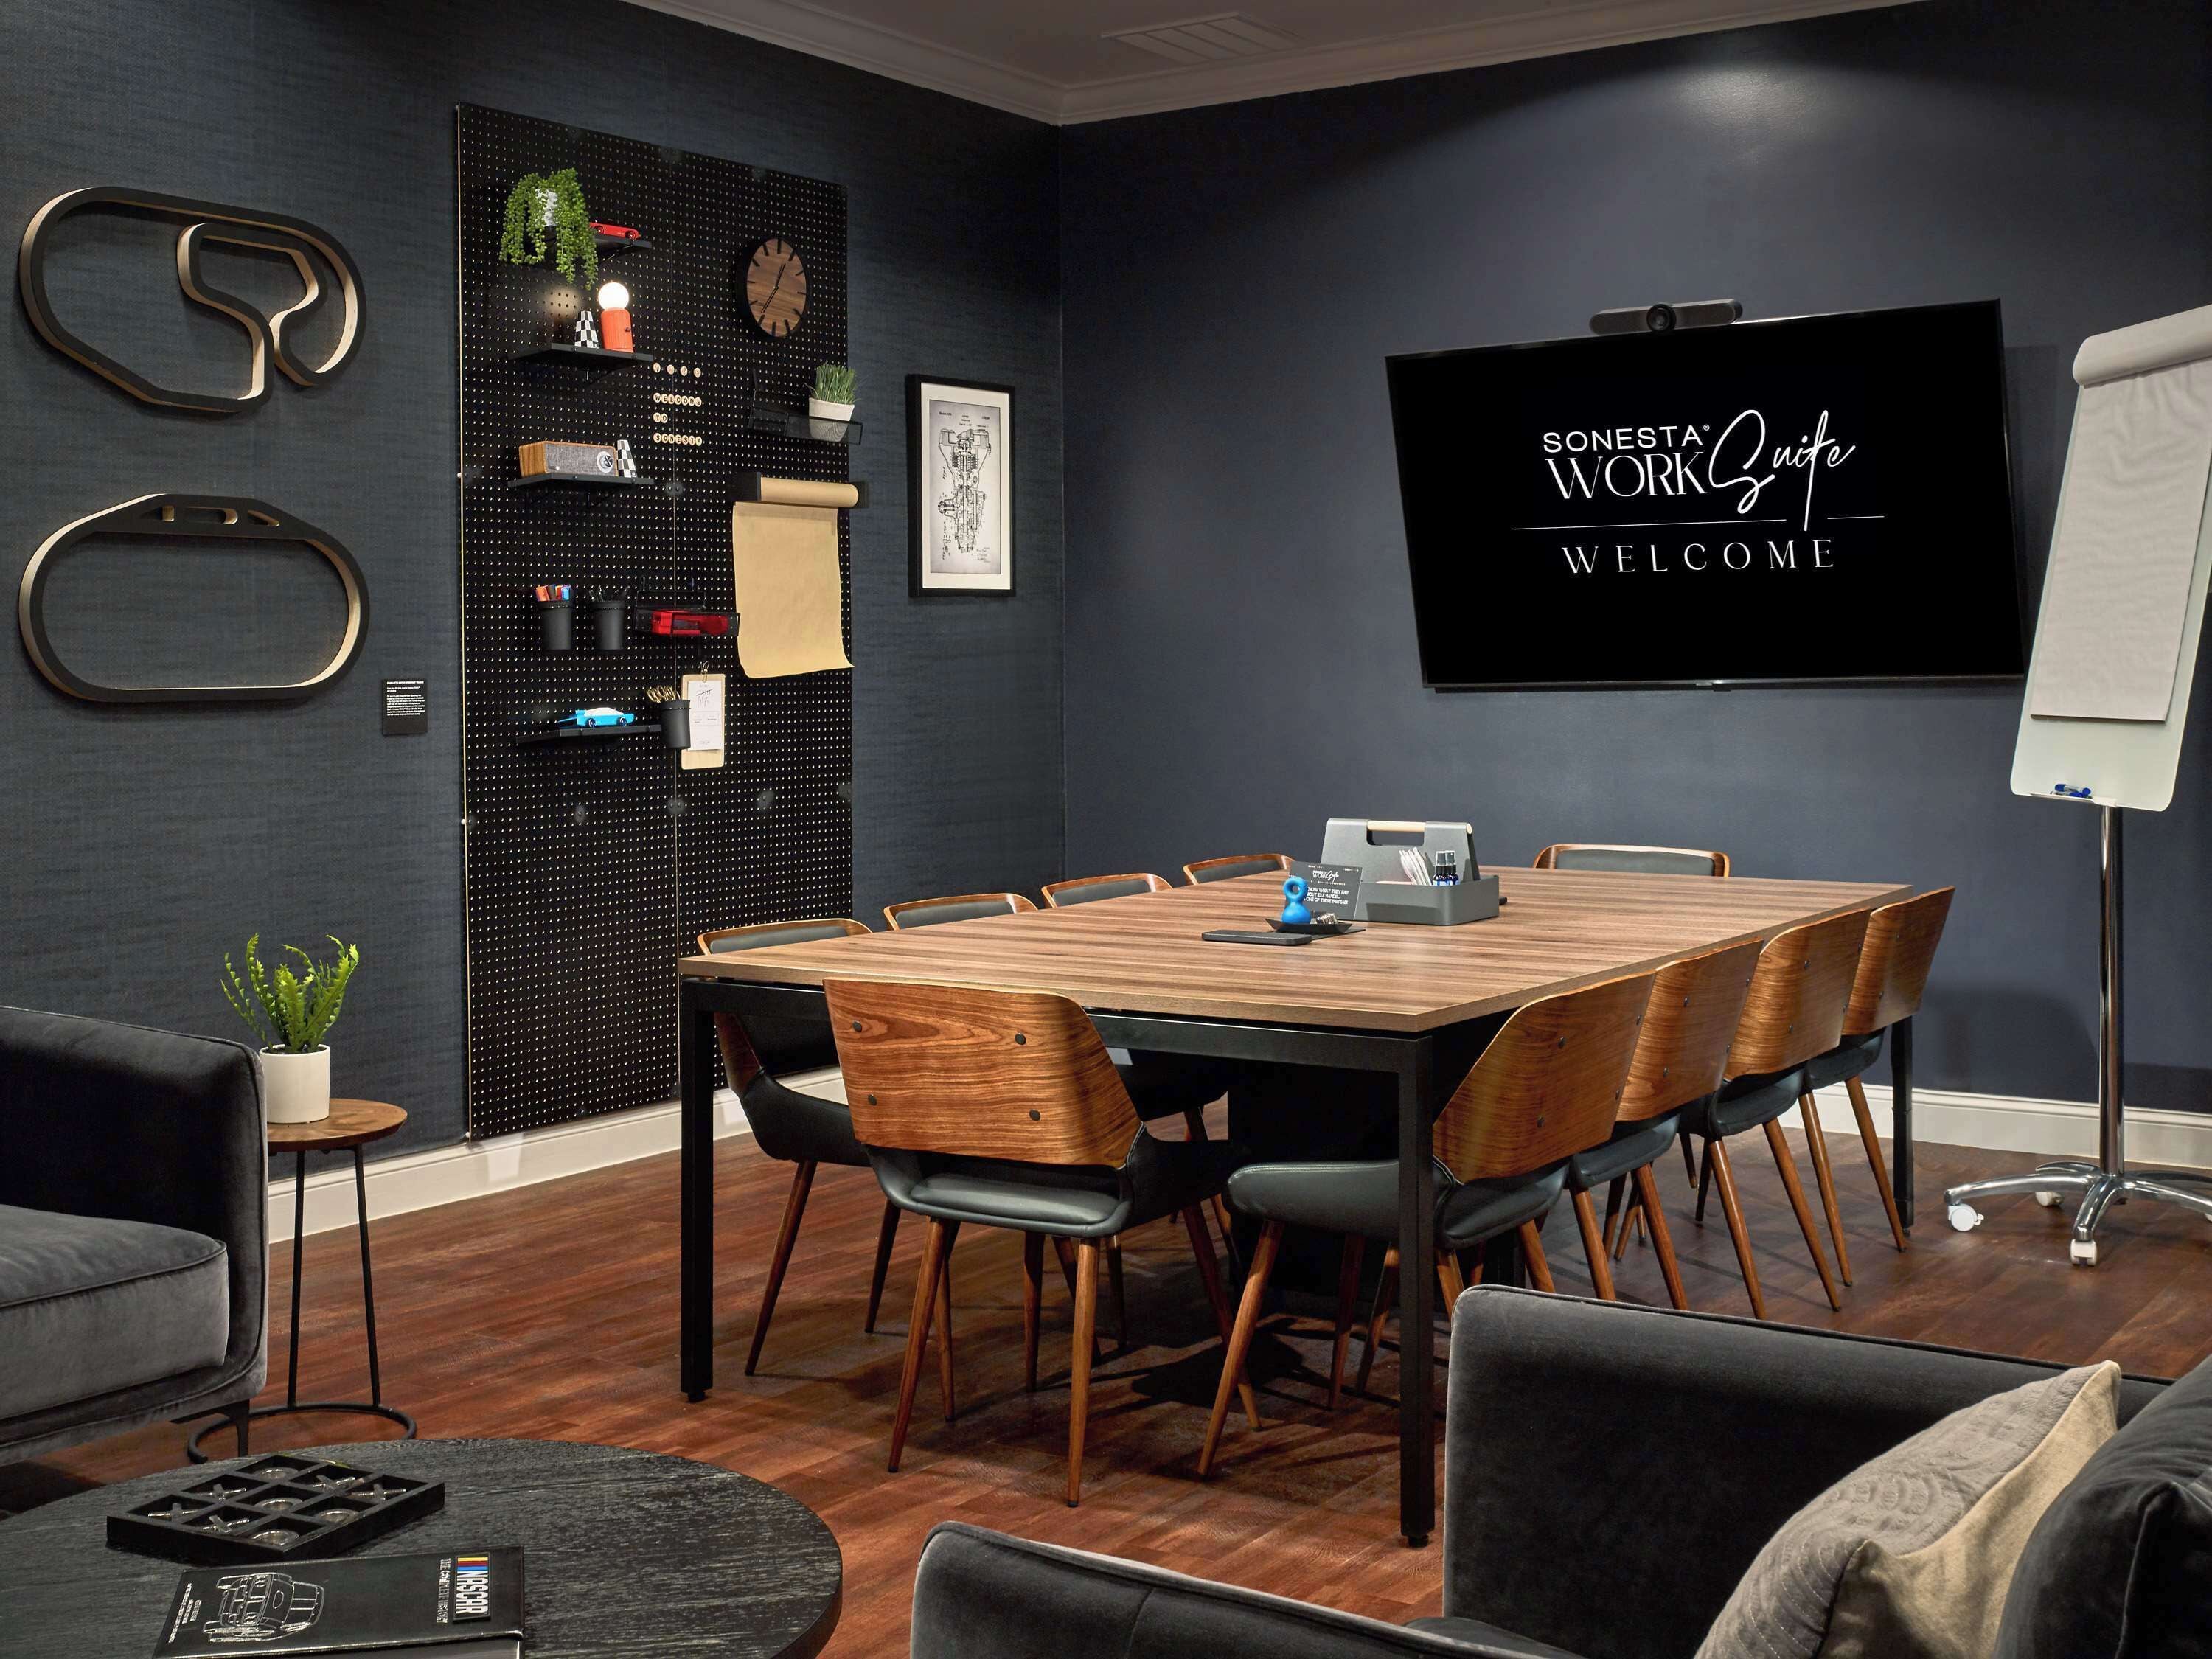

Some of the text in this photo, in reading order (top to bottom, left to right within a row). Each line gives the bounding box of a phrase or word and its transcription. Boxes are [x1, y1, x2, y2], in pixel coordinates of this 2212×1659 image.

[655, 394, 701, 405] WELCOME
[655, 414, 667, 422] TO
[655, 434, 702, 444] SONESTA
[1545, 409, 1856, 531] WORK Suite
[1562, 539, 1834, 574] WELCOME
[437, 1558, 451, 1624] THE COMPLETE HISTORY
[455, 1570, 489, 1614] NASCAR
